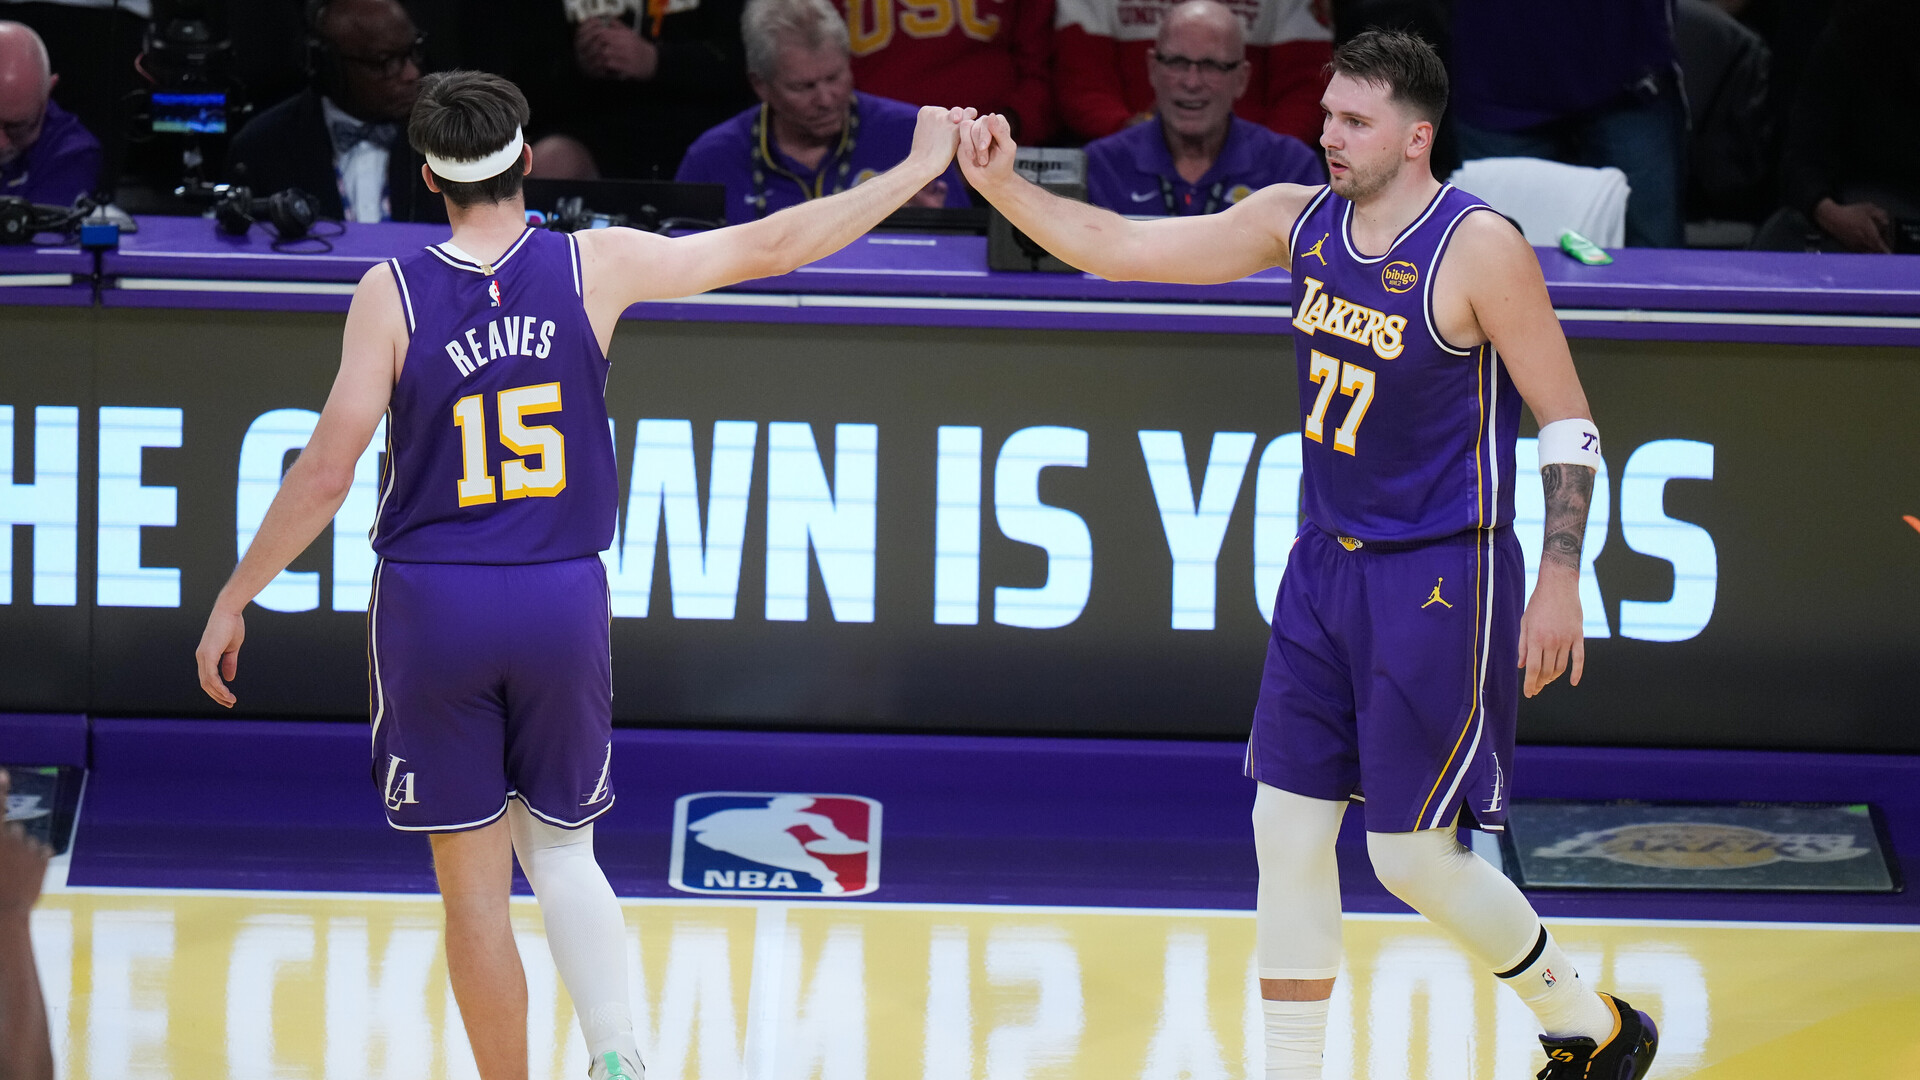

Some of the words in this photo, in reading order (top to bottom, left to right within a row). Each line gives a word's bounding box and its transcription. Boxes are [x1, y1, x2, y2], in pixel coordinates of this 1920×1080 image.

[847, 0, 1000, 56] USC
[1385, 268, 1416, 285] bibigo
[445, 315, 556, 377] REAVES
[1292, 276, 1408, 360] LAKERS
[1305, 349, 1376, 456] 77
[453, 381, 566, 508] 15
[0, 405, 182, 607] HE
[236, 408, 878, 623] CWN
[934, 425, 1093, 629] IS
[385, 753, 420, 811] LA
[703, 869, 799, 889] NBA
